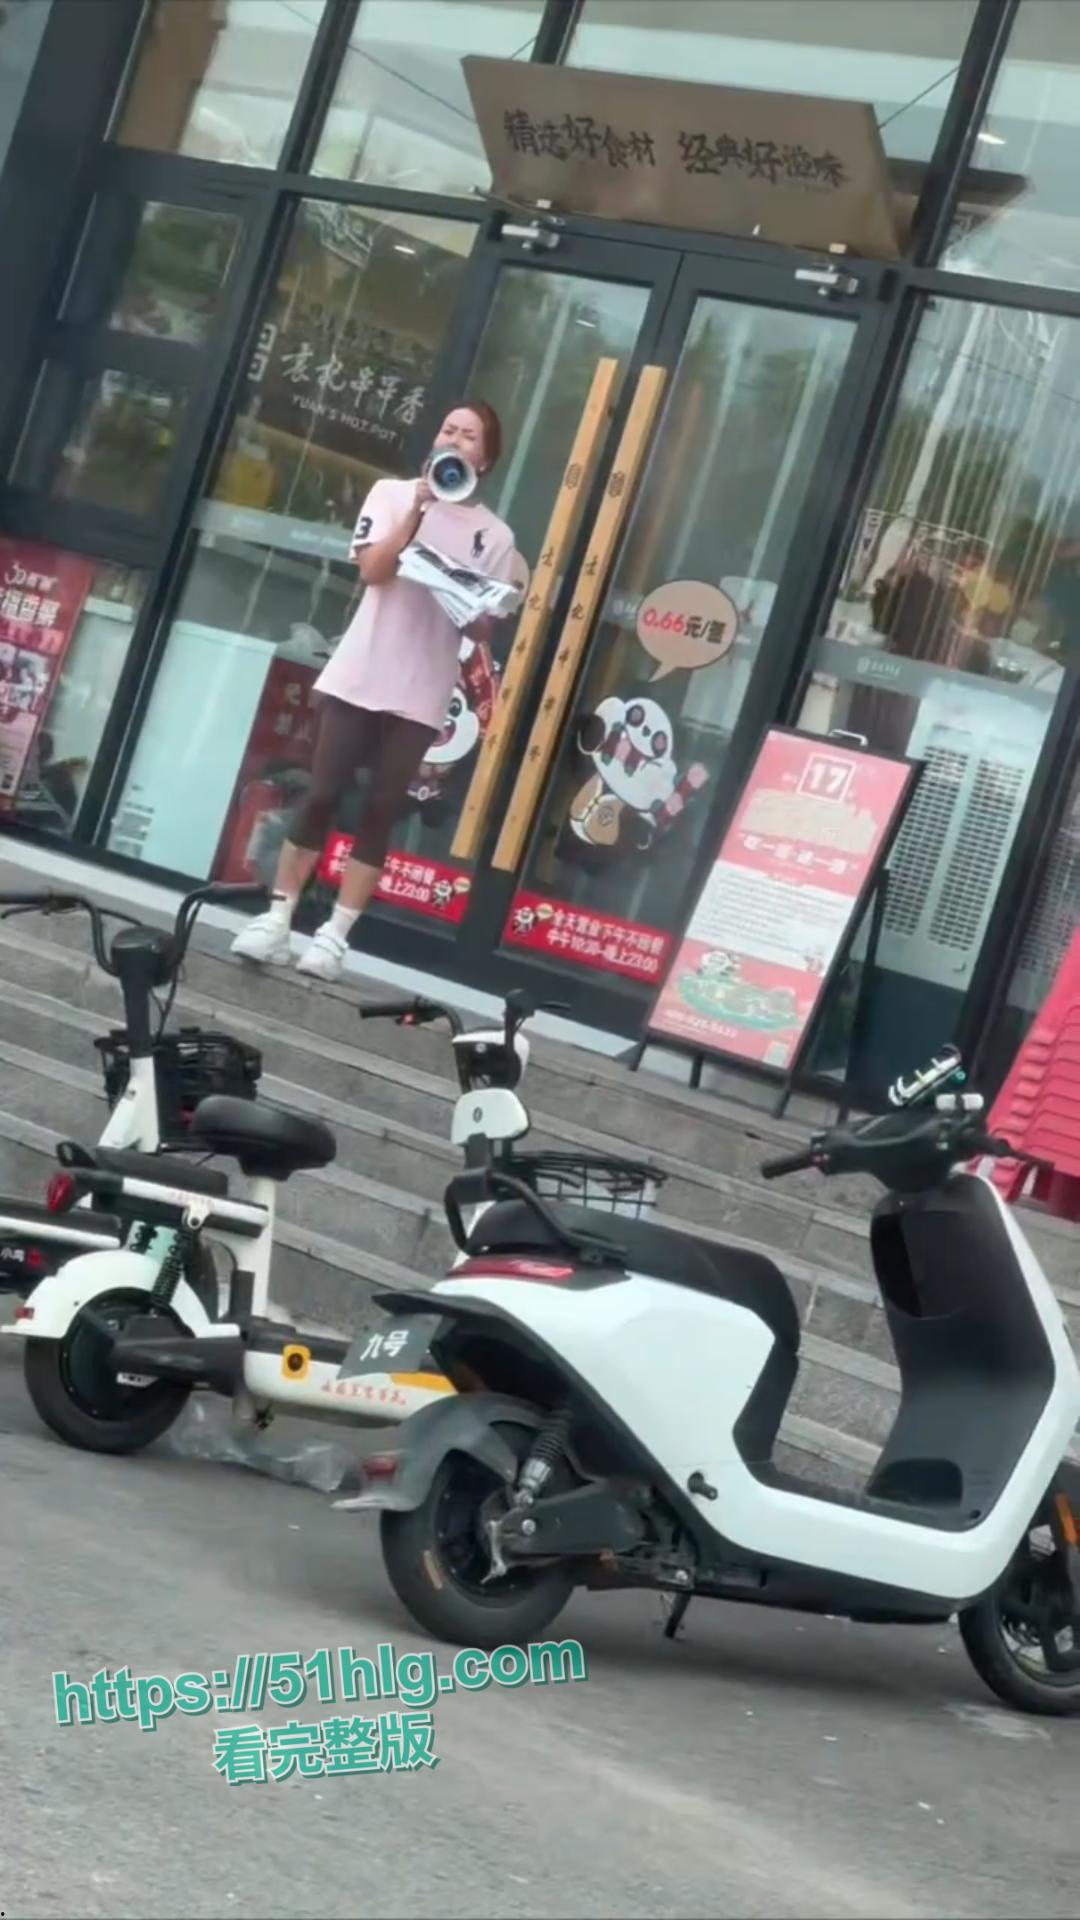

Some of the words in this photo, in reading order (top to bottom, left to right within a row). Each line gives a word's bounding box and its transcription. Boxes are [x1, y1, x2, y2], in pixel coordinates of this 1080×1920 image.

[503, 108, 656, 169] 精选好食材
[677, 130, 848, 187] 经典好滋味
[370, 423, 398, 442] POT
[354, 516, 374, 540] 3
[809, 762, 849, 794] 17
[360, 1329, 410, 1361] 九号
